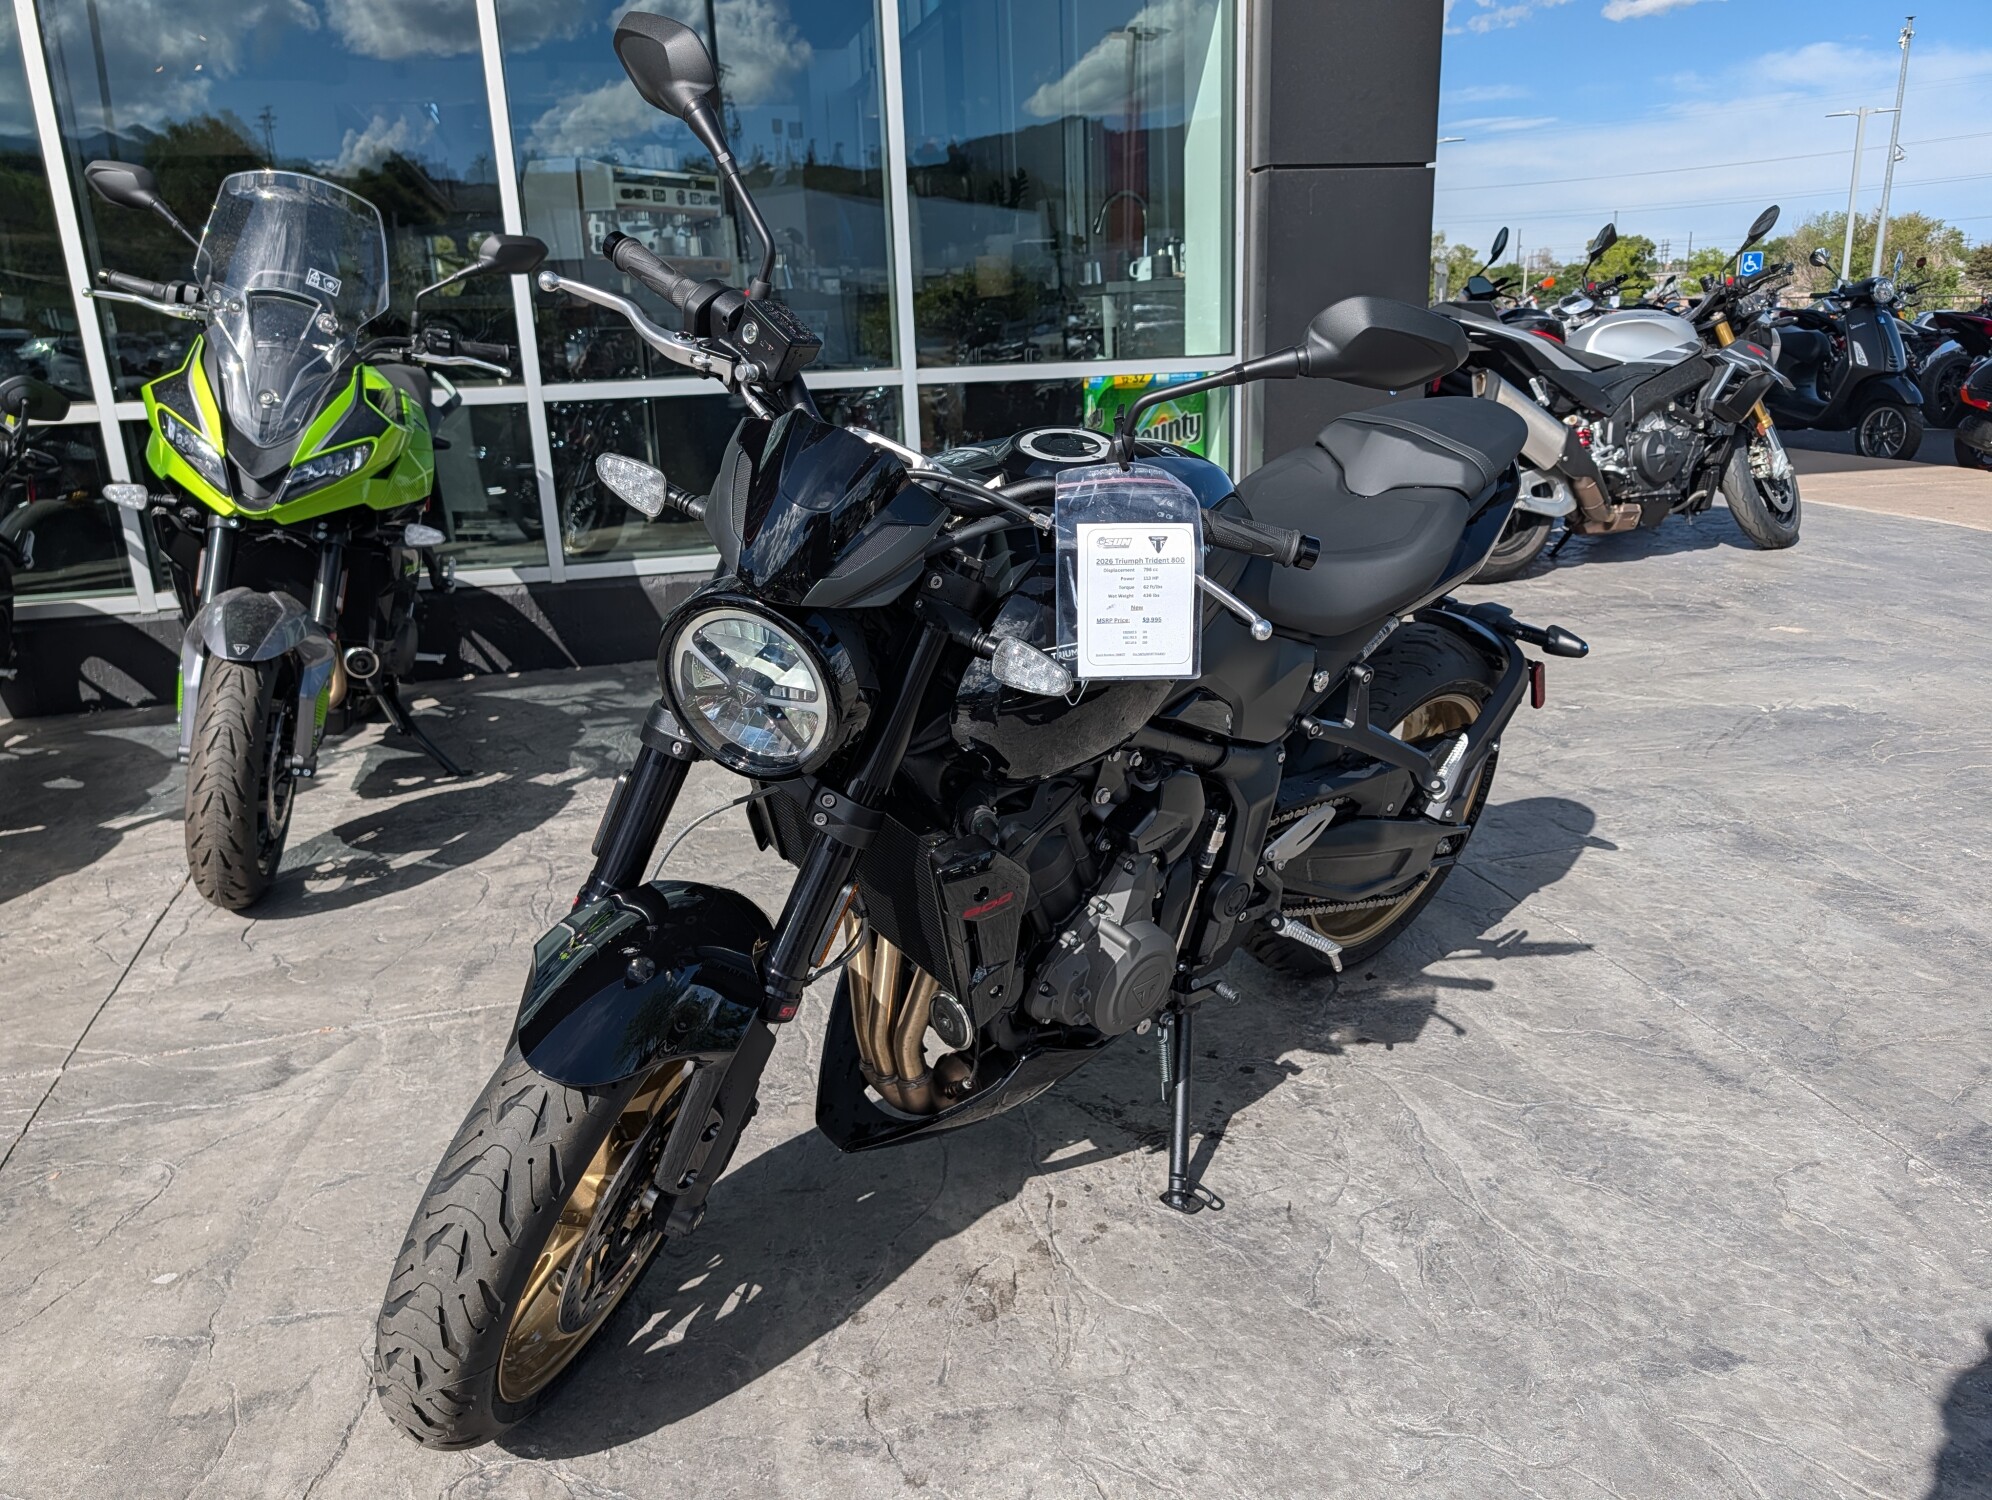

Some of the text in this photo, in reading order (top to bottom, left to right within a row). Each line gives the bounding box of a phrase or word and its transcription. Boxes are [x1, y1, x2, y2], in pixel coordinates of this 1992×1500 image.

[1133, 411, 1202, 443] ounty
[1096, 558, 1114, 566] 2026
[1115, 558, 1144, 566] Triumph
